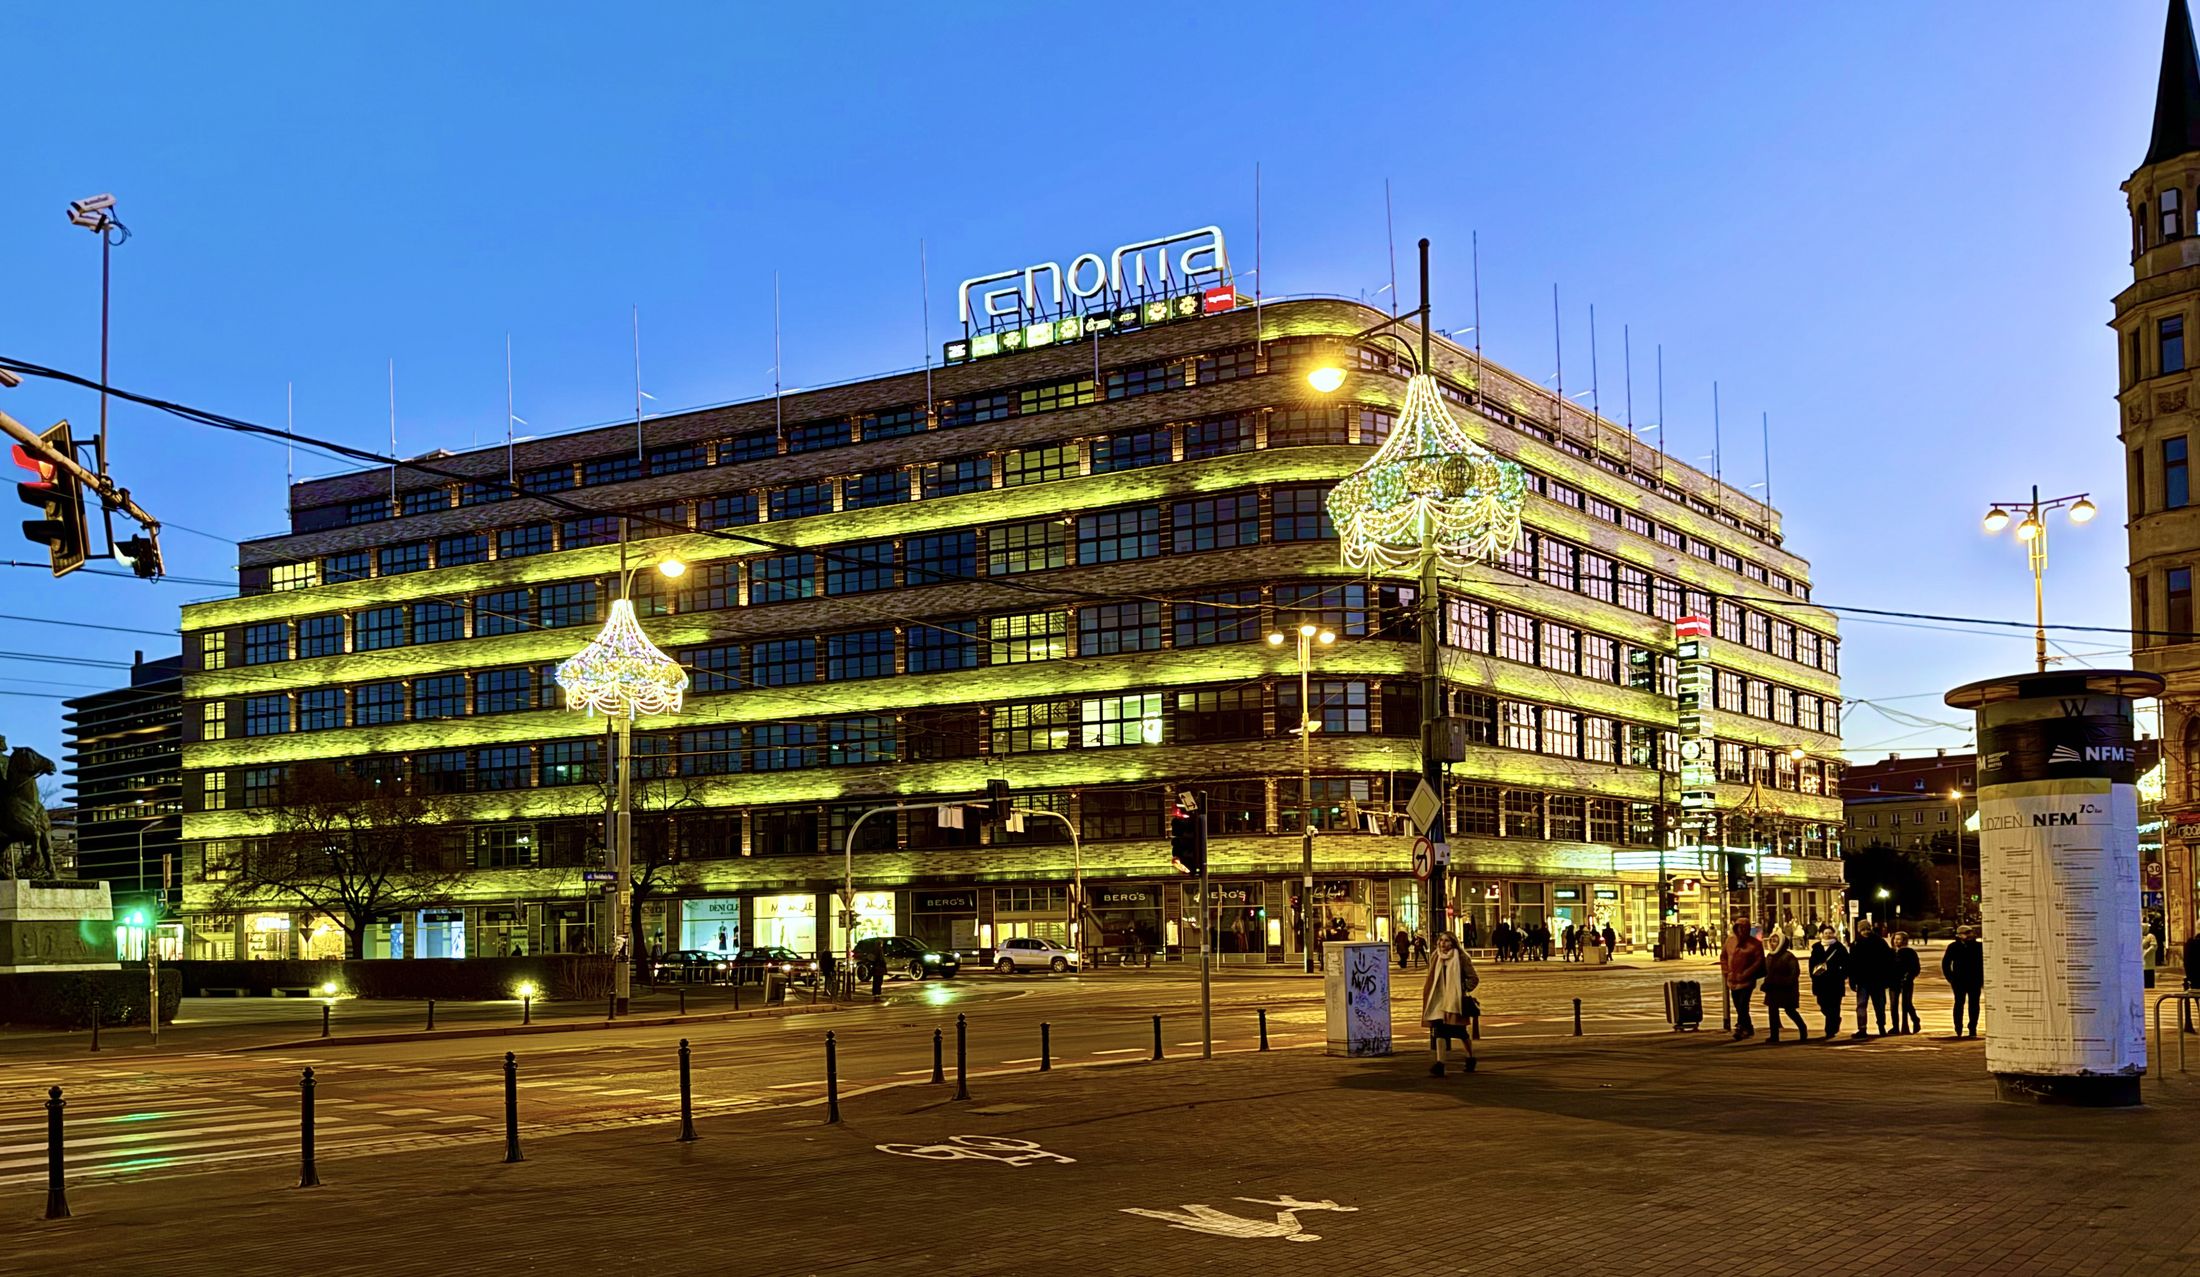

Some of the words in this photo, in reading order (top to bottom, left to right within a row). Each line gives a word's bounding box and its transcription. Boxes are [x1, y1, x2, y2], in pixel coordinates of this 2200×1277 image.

[959, 225, 1225, 322] renoma
[2085, 746, 2124, 762] NFM
[2033, 812, 2078, 827] NFM
[1103, 892, 1146, 901] BERG'S
[1206, 889, 1246, 899] ERG'S
[927, 897, 965, 906] BERG'S
